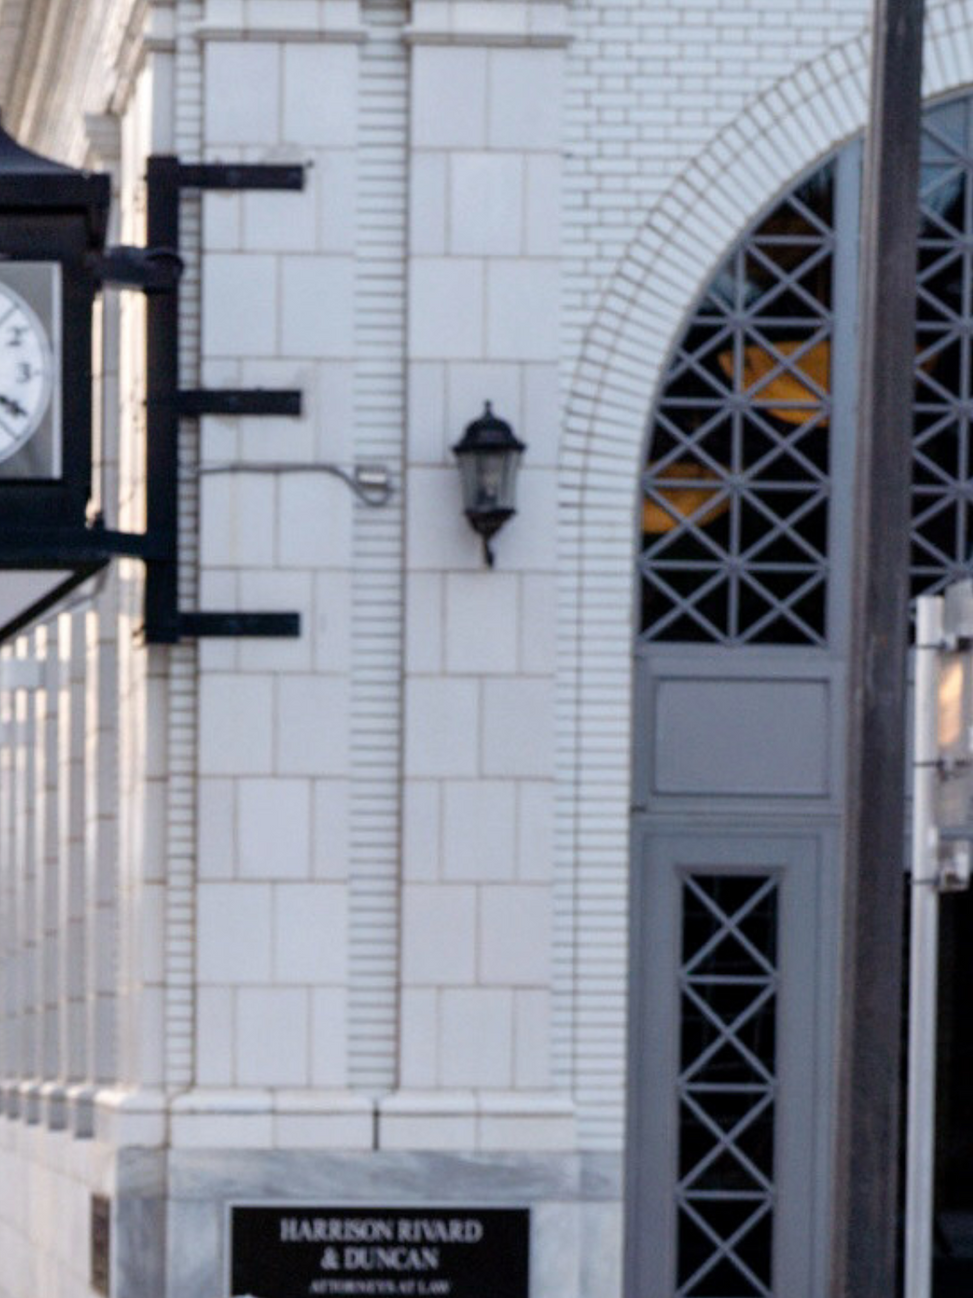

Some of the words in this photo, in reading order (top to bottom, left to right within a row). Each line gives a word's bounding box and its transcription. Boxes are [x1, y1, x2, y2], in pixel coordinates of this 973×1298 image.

[7, 327, 22, 347] 2
[17, 363, 31, 383] 3
[280, 1218, 394, 1242] HARRISON
[398, 1219, 483, 1243] RIVARD
[320, 1247, 339, 1270] &
[344, 1248, 439, 1270] DUNCAN
[310, 1279, 396, 1294] ATTORNEYS
[398, 1279, 415, 1294] AT
[417, 1279, 450, 1294] LAW
